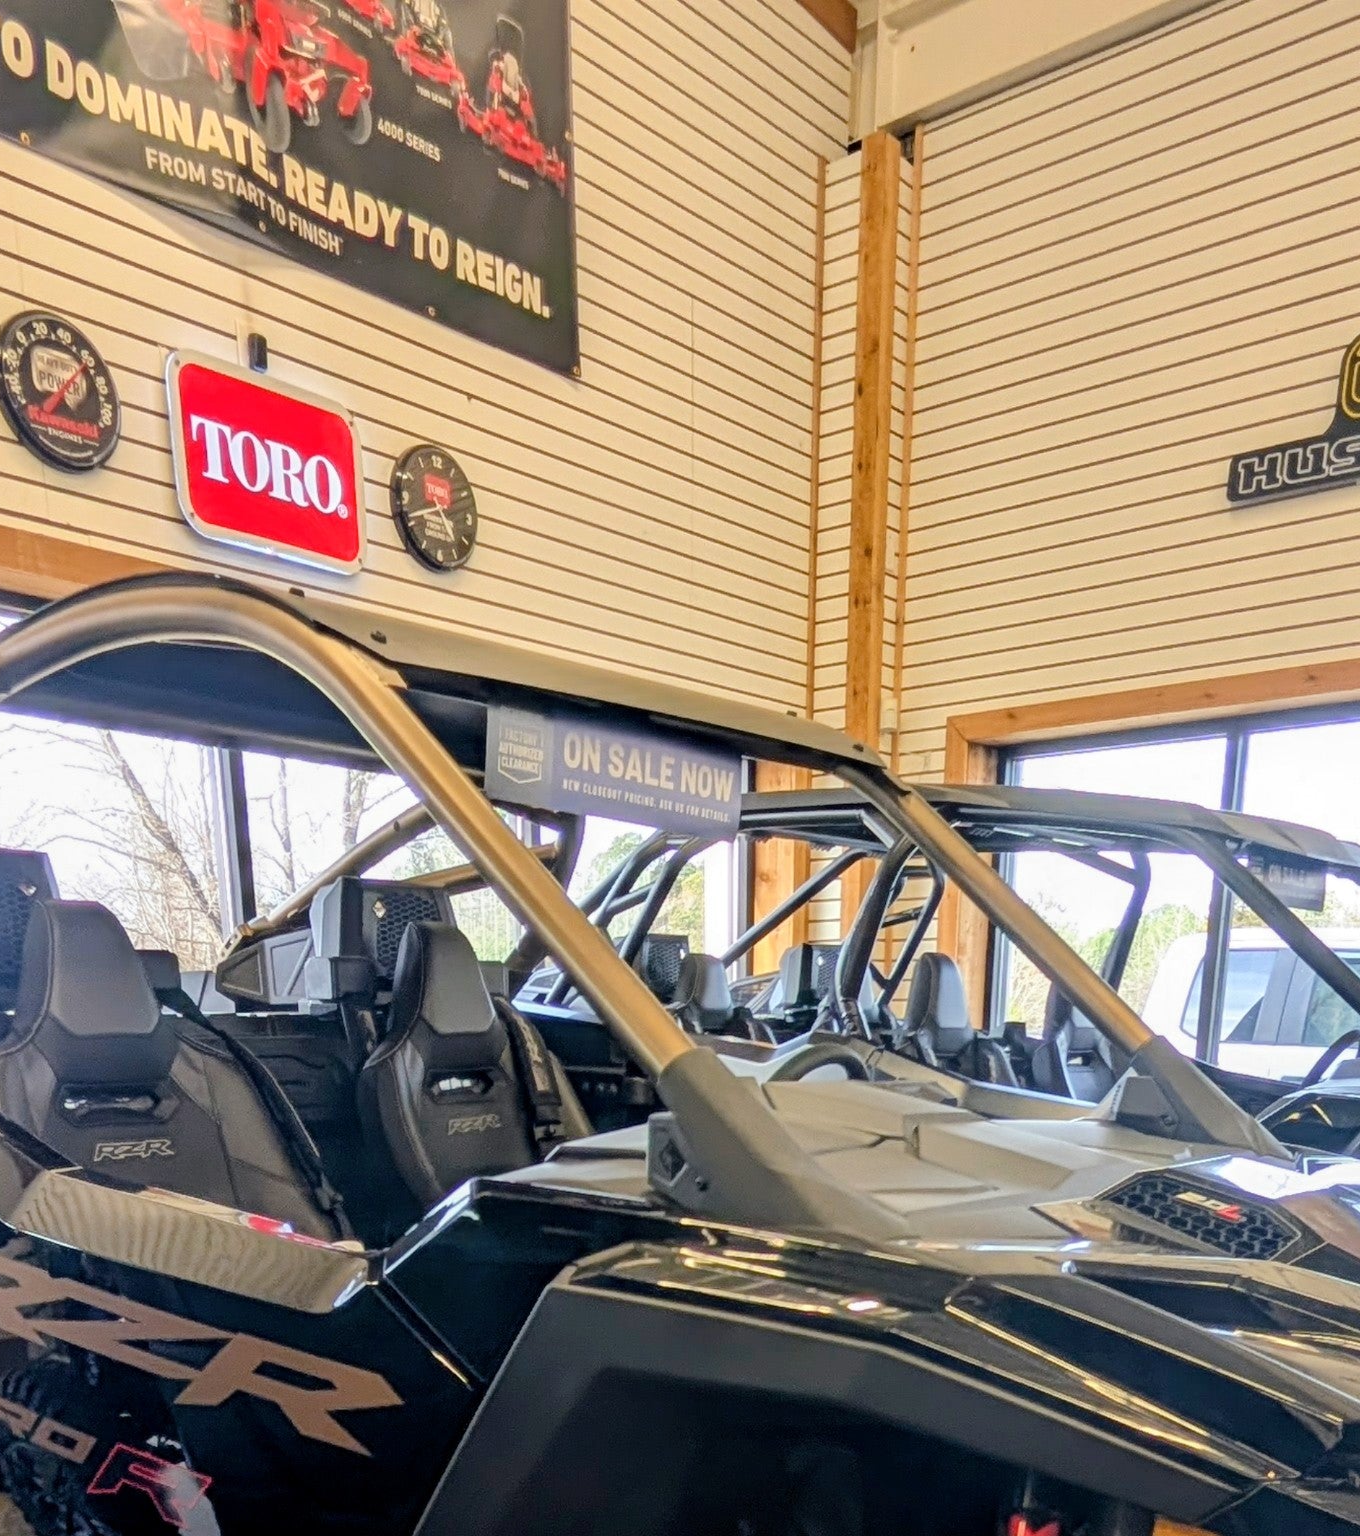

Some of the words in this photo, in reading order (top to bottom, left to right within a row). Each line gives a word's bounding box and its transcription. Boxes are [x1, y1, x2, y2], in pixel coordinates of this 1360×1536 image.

[45, 39, 278, 188] DOMINATE.
[283, 153, 403, 249] READY
[408, 213, 450, 271] TO
[456, 240, 551, 319] REIGN.
[377, 117, 404, 143] 4000
[405, 131, 441, 163] SERIES
[145, 146, 207, 187] FROM
[211, 168, 266, 213] START
[268, 198, 287, 228] TO
[288, 210, 343, 257] FINISH
[190, 413, 343, 515] TORO
[563, 731, 601, 775] ON
[607, 743, 675, 791] SALE
[680, 761, 735, 802] NOW
[94, 1138, 175, 1162] RZR
[87, 1442, 213, 1530] R
